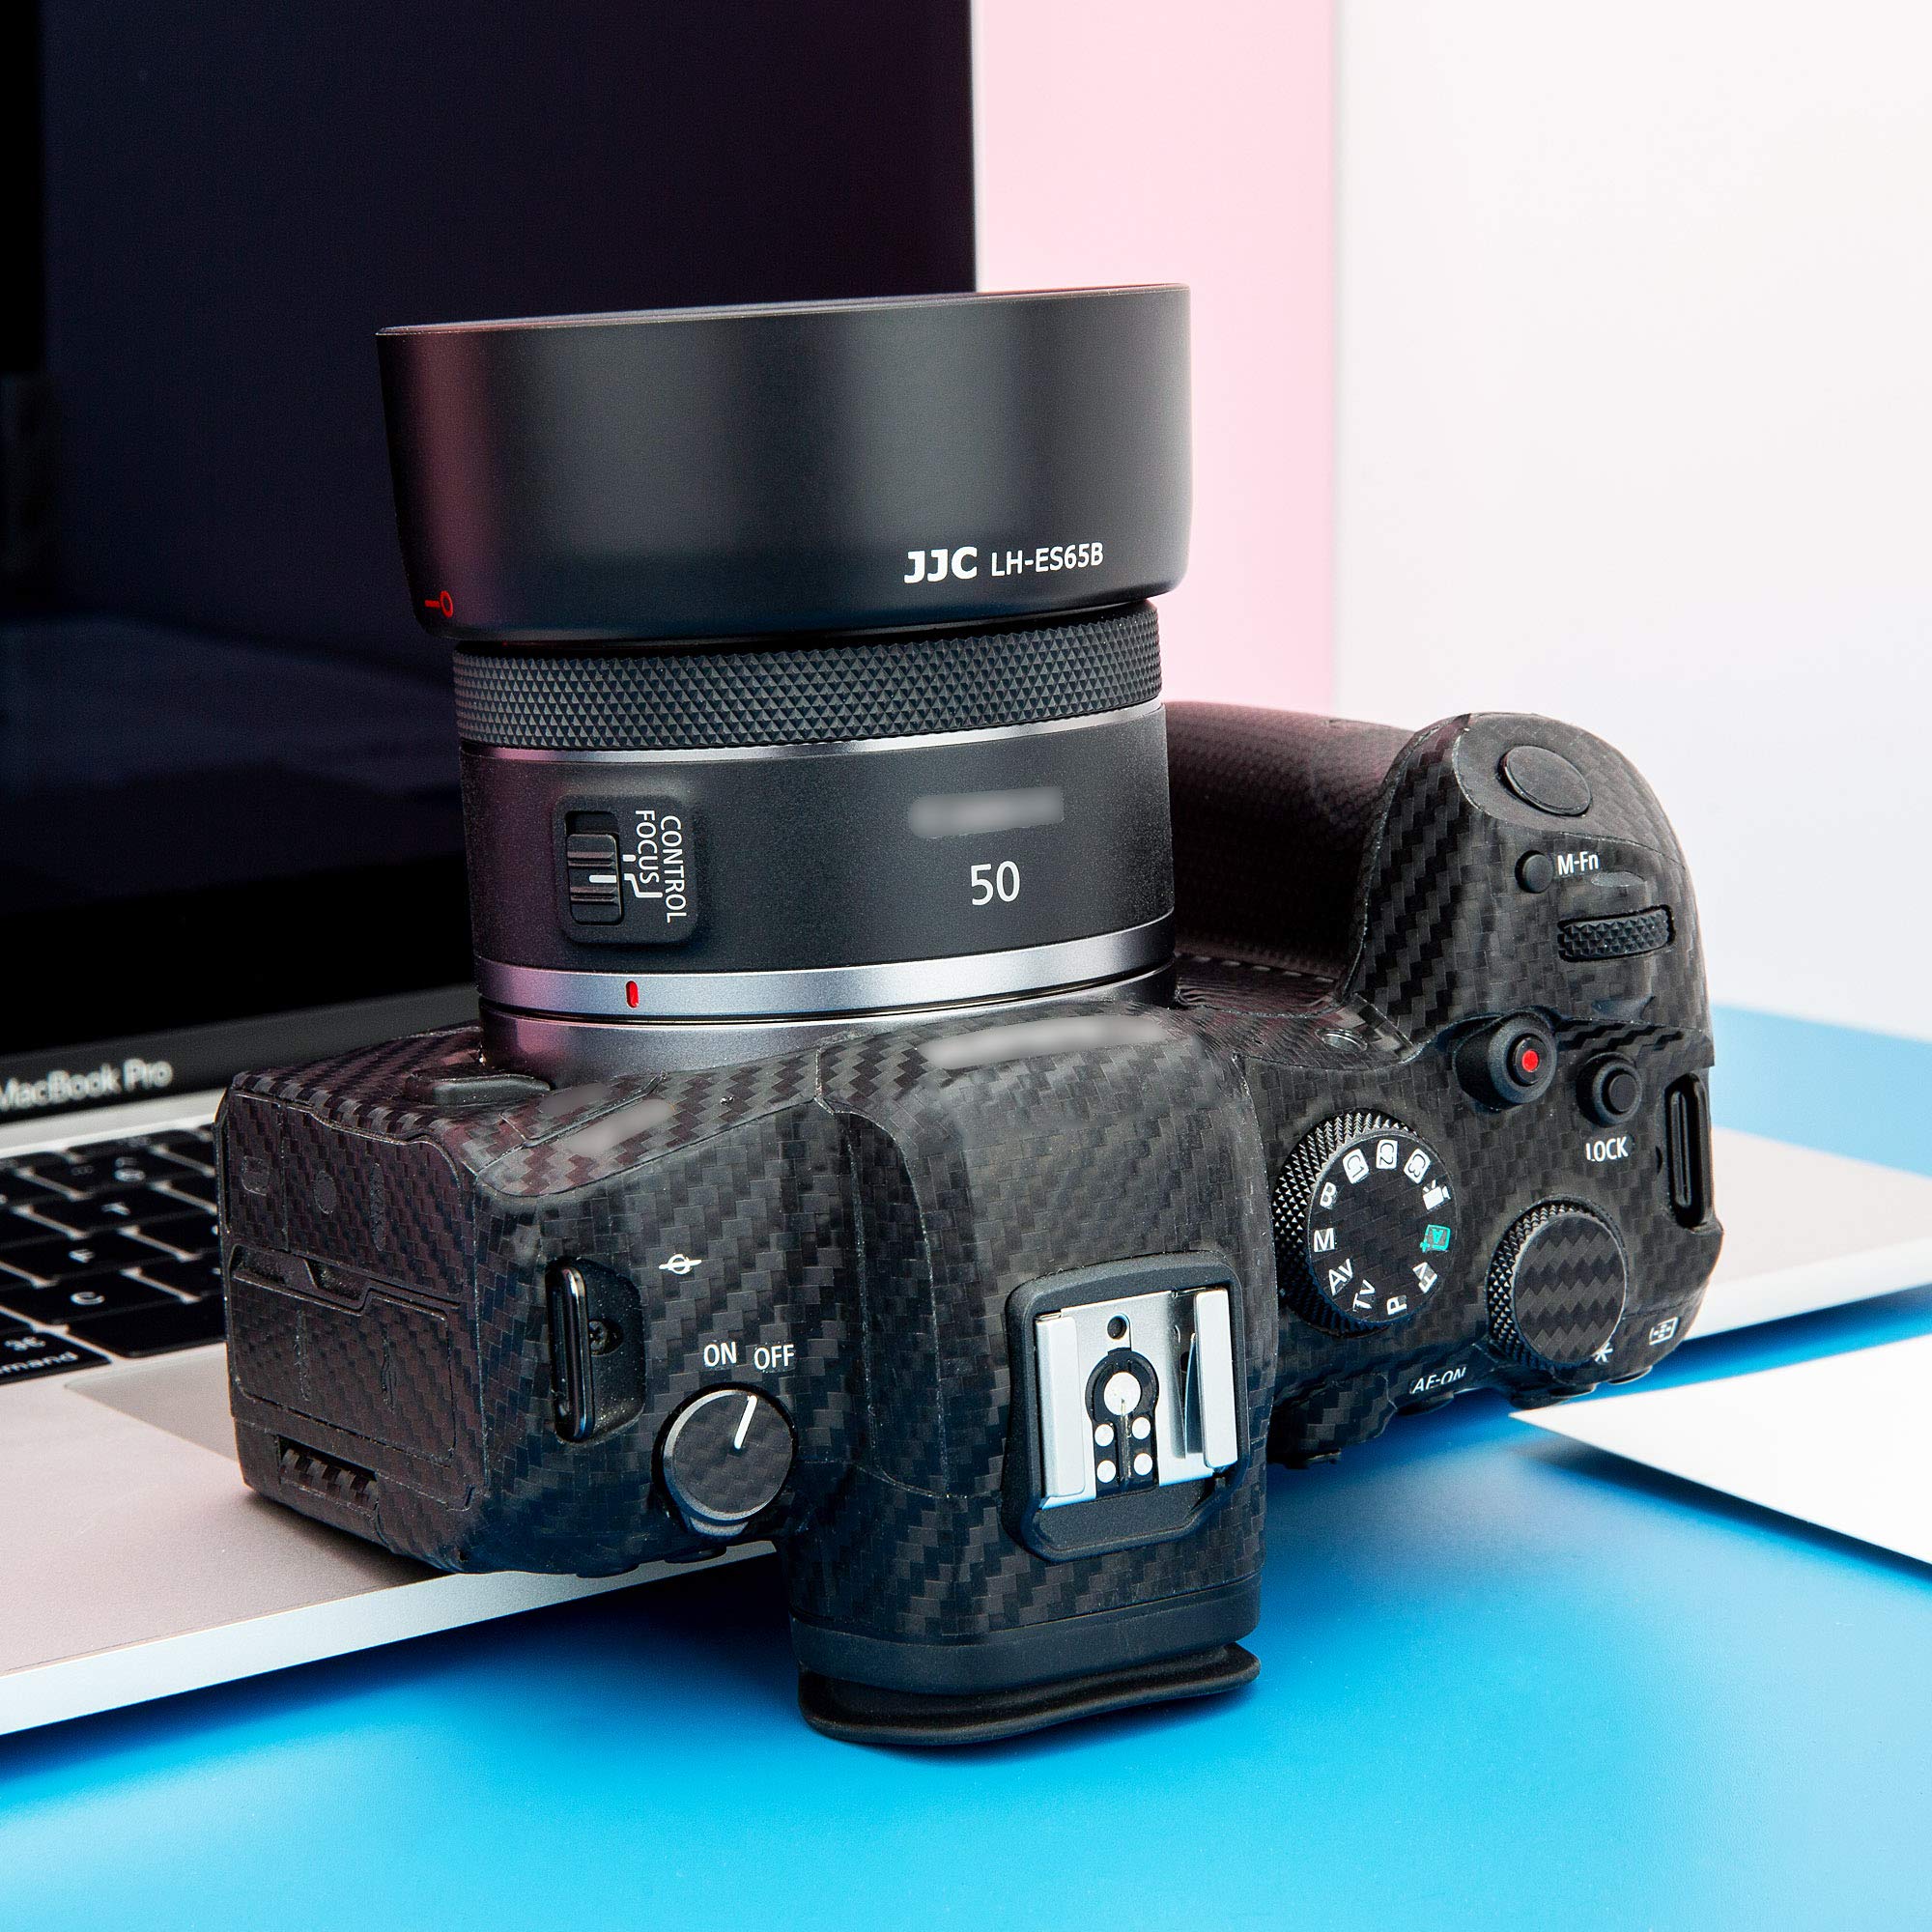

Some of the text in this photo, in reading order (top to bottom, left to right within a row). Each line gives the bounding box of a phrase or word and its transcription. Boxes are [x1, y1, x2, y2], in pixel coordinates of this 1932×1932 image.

[903, 542, 1104, 583] JJC LH-ES65B
[636, 810, 660, 885] FOCUS
[660, 815, 688, 923] CONTROL
[1557, 851, 1600, 875] M-Fn
[971, 861, 1020, 906] 50
[123, 1058, 174, 1092] Pro
[1378, 1139, 1397, 1168] C2
[1586, 1136, 1629, 1162] LOCK
[1345, 1151, 1367, 1180] C1
[1406, 1151, 1428, 1181] C3
[1320, 1181, 1337, 1209] B
[1313, 1227, 1336, 1253] M
[1386, 1294, 1407, 1315] P
[703, 1341, 795, 1371] ON OFF
[1410, 1366, 1466, 1395] AF-ON
